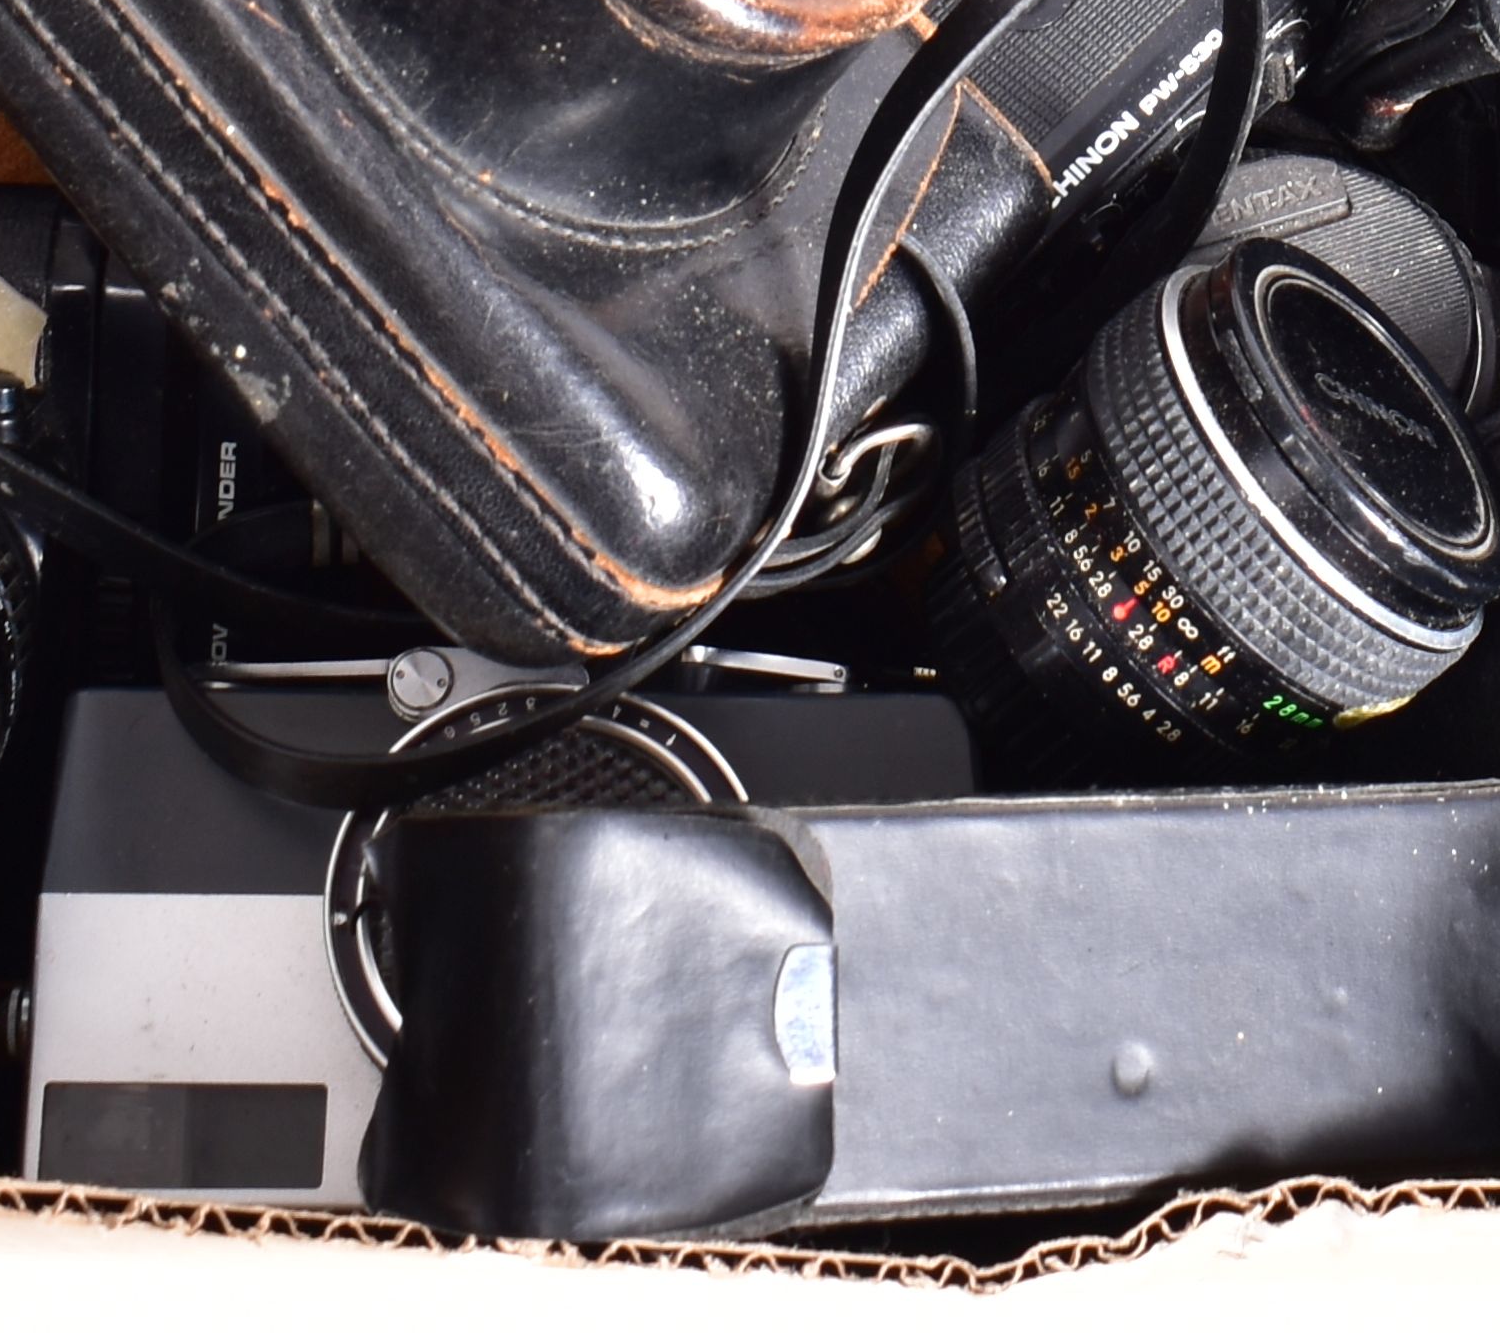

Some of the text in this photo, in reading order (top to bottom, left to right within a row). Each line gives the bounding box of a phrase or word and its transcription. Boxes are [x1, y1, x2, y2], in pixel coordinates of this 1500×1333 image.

[1211, 174, 1326, 228] ENTAX
[1049, 496, 1066, 517] 11
[1064, 527, 1079, 545] 8
[1156, 654, 1178, 675] R
[1173, 670, 1190, 688] 8
[1199, 691, 1219, 711] 11
[1084, 502, 1223, 676] 2 3 5 10 m
[1101, 496, 1117, 511] 7
[1123, 529, 1142, 555] 10
[1142, 559, 1163, 583] 15
[1162, 584, 1186, 610] 30
[1217, 644, 1237, 664] ft
[1046, 592, 1182, 743] 22 16 11 8 5.6 4 2.8
[1262, 694, 1324, 728] 28mm
